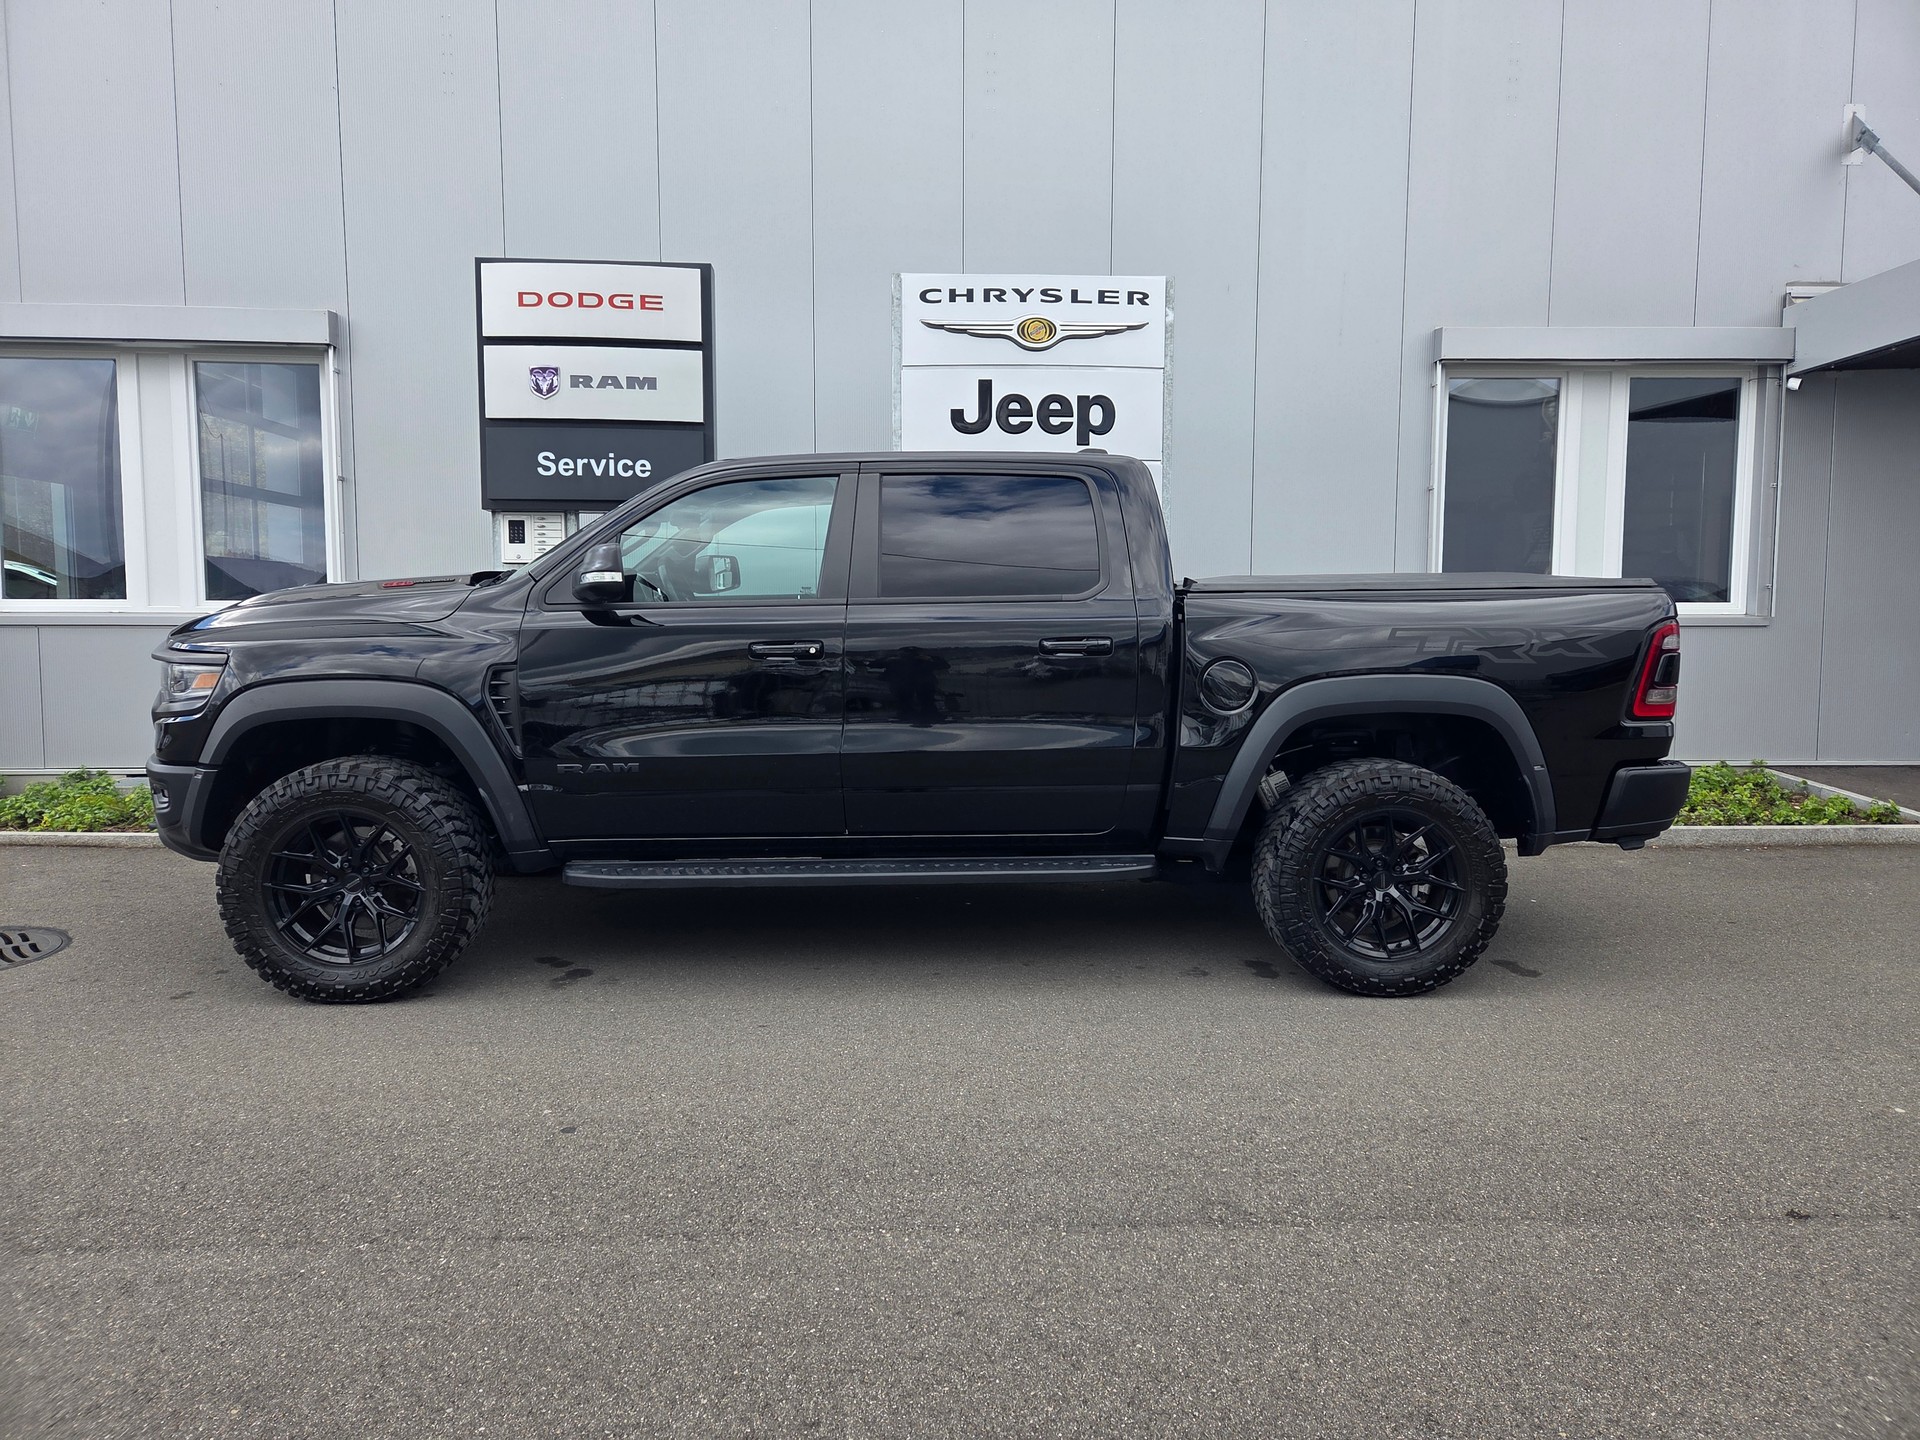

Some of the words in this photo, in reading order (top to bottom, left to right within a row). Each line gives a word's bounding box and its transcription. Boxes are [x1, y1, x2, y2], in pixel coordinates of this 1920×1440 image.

[517, 291, 664, 311] DODGE
[919, 287, 1150, 306] CHRYSLER
[569, 374, 658, 391] RAM
[950, 379, 1116, 446] Jeep
[536, 451, 652, 477] Service
[1388, 627, 1621, 664] TRX
[556, 763, 640, 774] RAM
